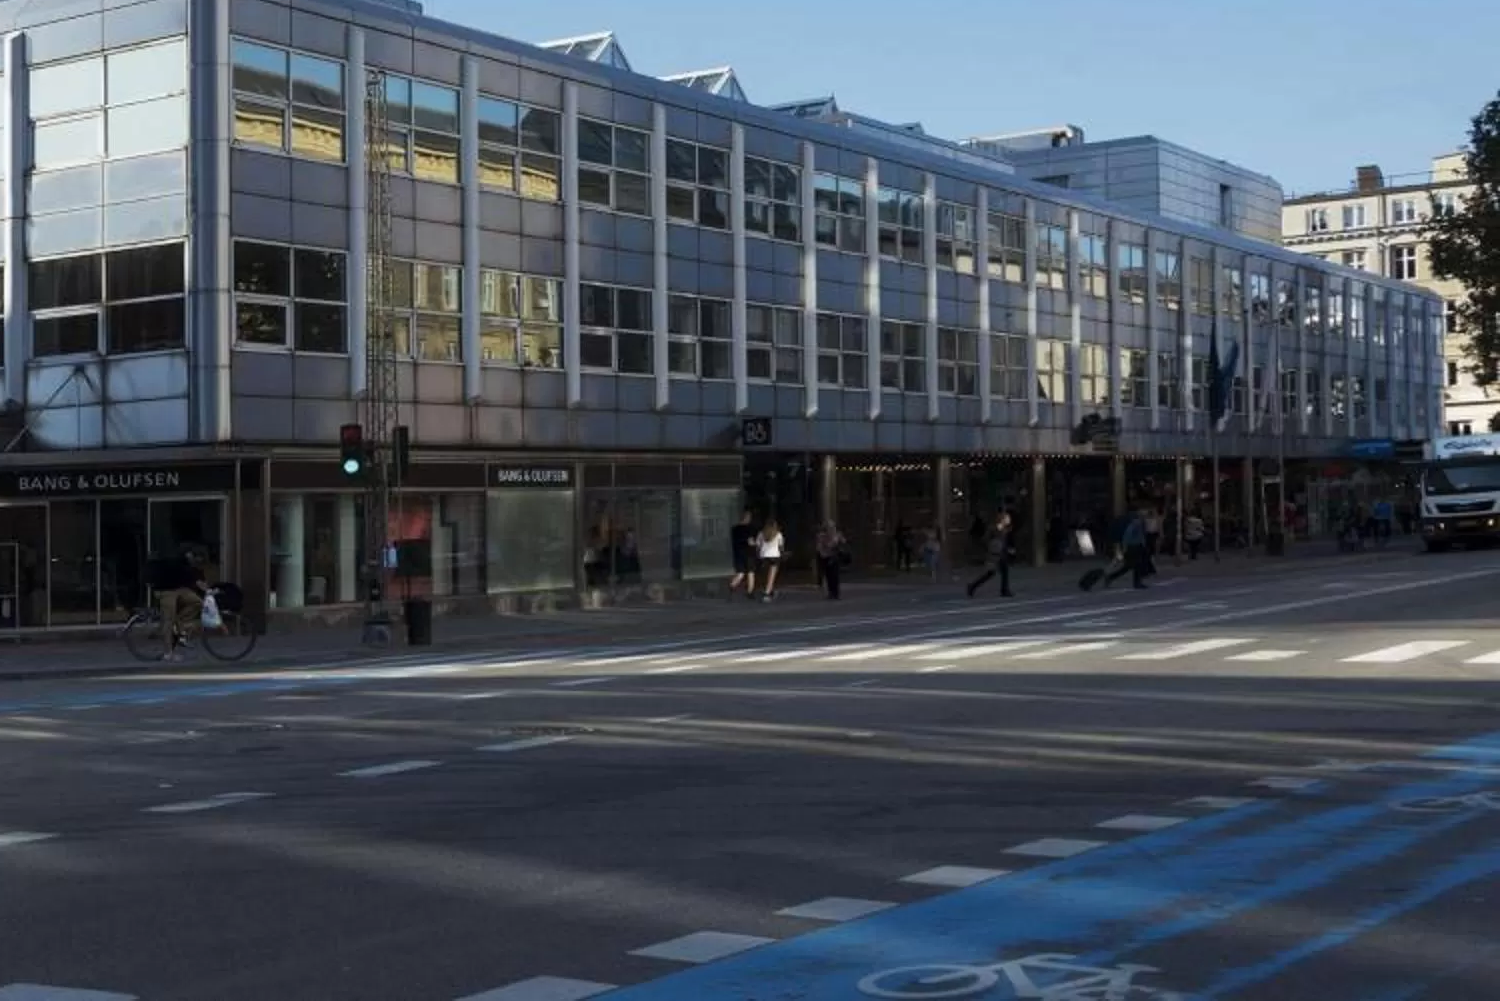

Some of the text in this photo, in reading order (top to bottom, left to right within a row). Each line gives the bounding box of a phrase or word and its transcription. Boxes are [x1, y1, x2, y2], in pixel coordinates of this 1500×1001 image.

[18, 471, 180, 491] BANG & OLUFSEN
